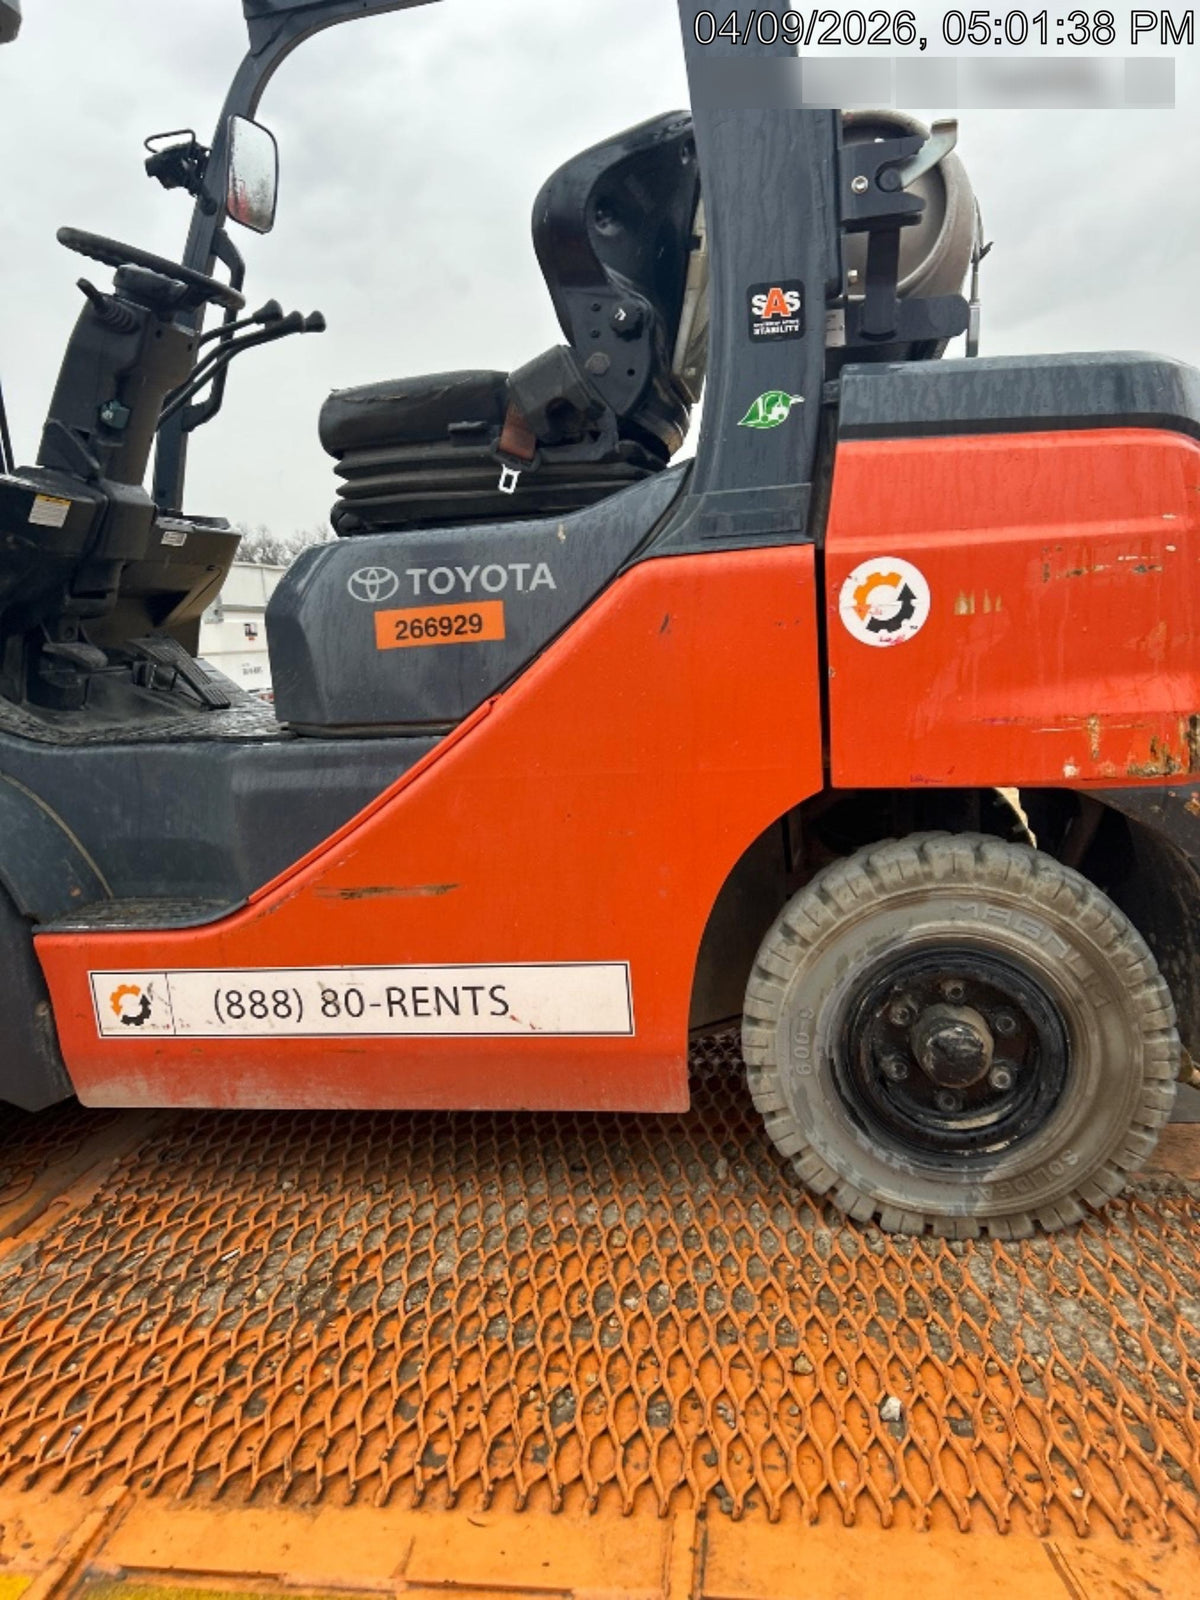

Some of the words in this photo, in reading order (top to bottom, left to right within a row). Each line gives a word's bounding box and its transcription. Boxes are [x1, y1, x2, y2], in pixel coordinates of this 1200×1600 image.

[751, 287, 801, 319] SAS
[406, 562, 557, 595] TOYOTA
[395, 613, 483, 640] 266929
[214, 987, 304, 1024] (888)
[321, 984, 510, 1018] 80-RENTS
